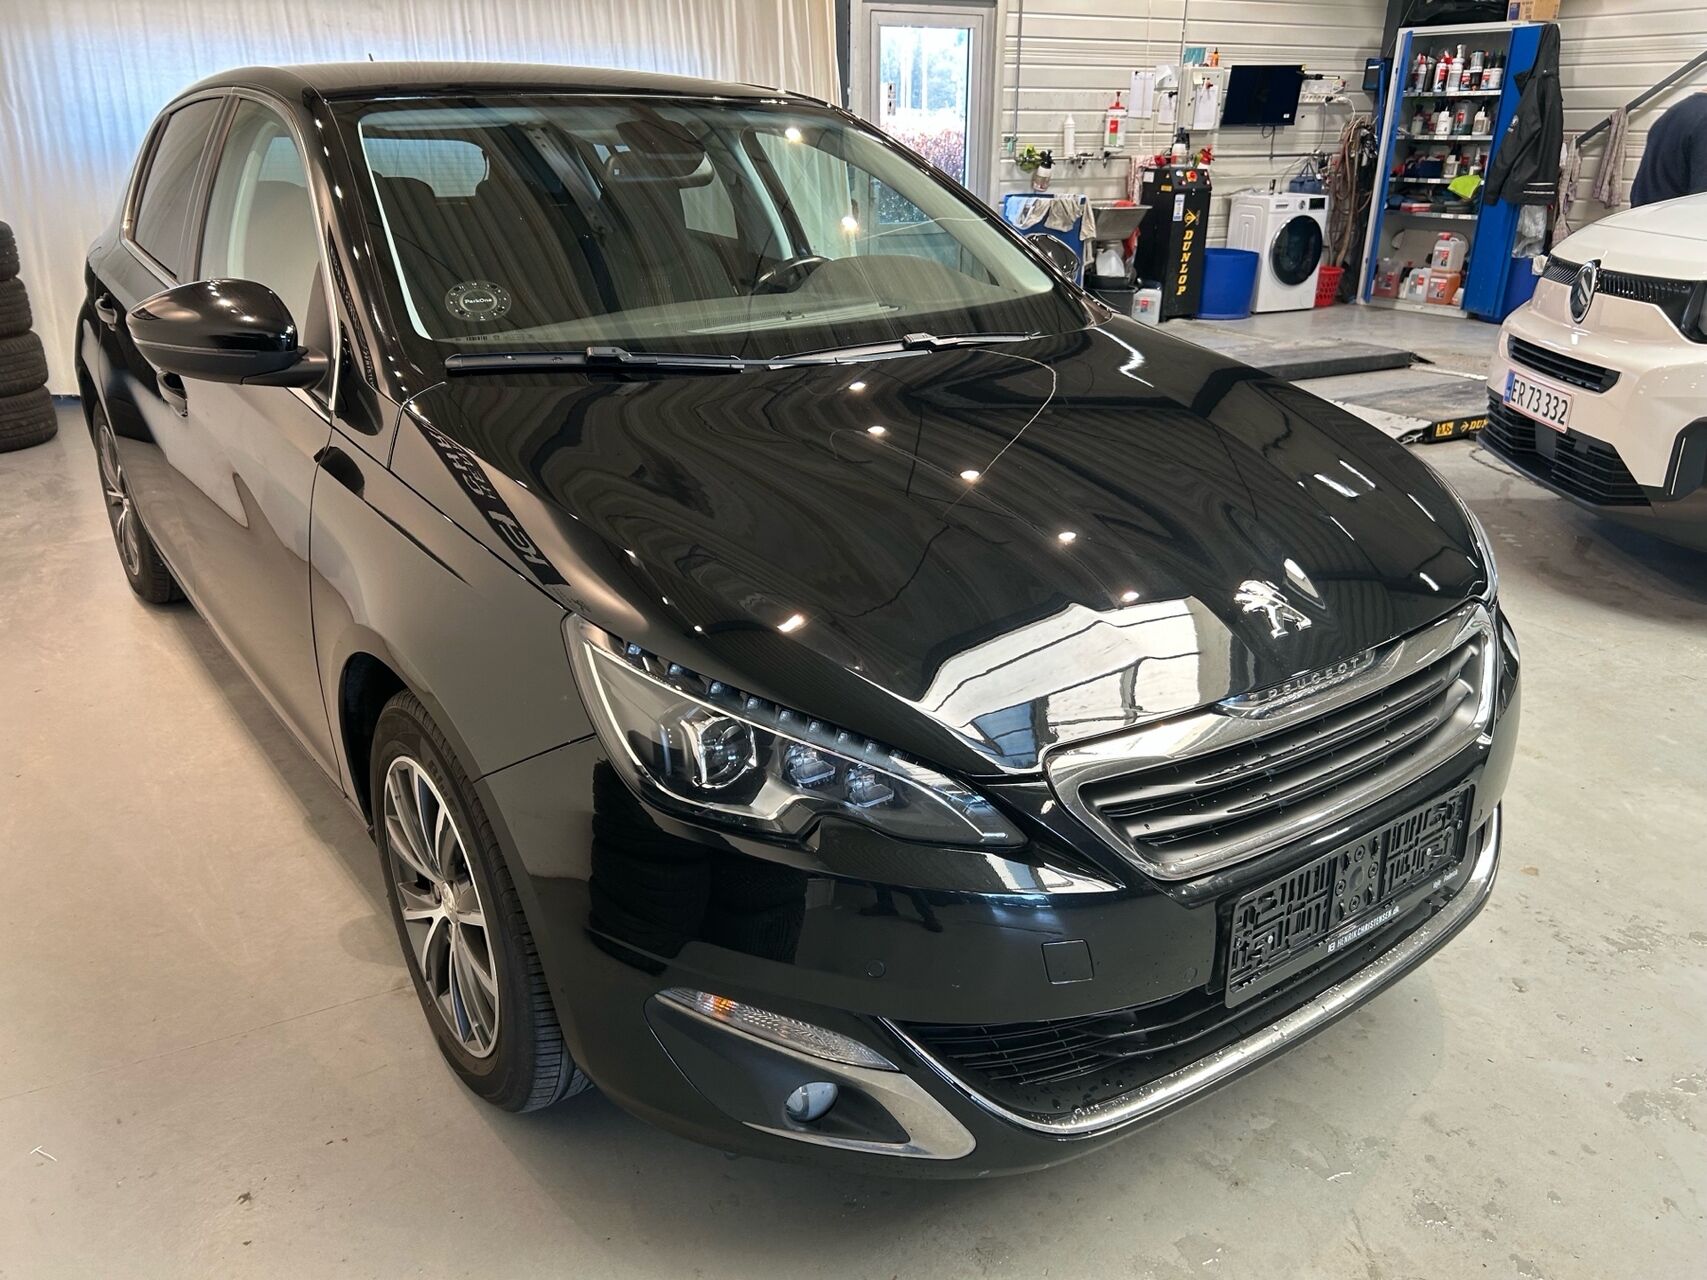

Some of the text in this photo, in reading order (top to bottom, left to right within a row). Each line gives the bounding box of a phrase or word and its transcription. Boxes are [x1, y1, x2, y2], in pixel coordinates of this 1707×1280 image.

[1176, 229, 1194, 296] DUNLOP
[1511, 379, 1568, 425] ER 73 332
[1268, 657, 1359, 701] PEUGEOT
